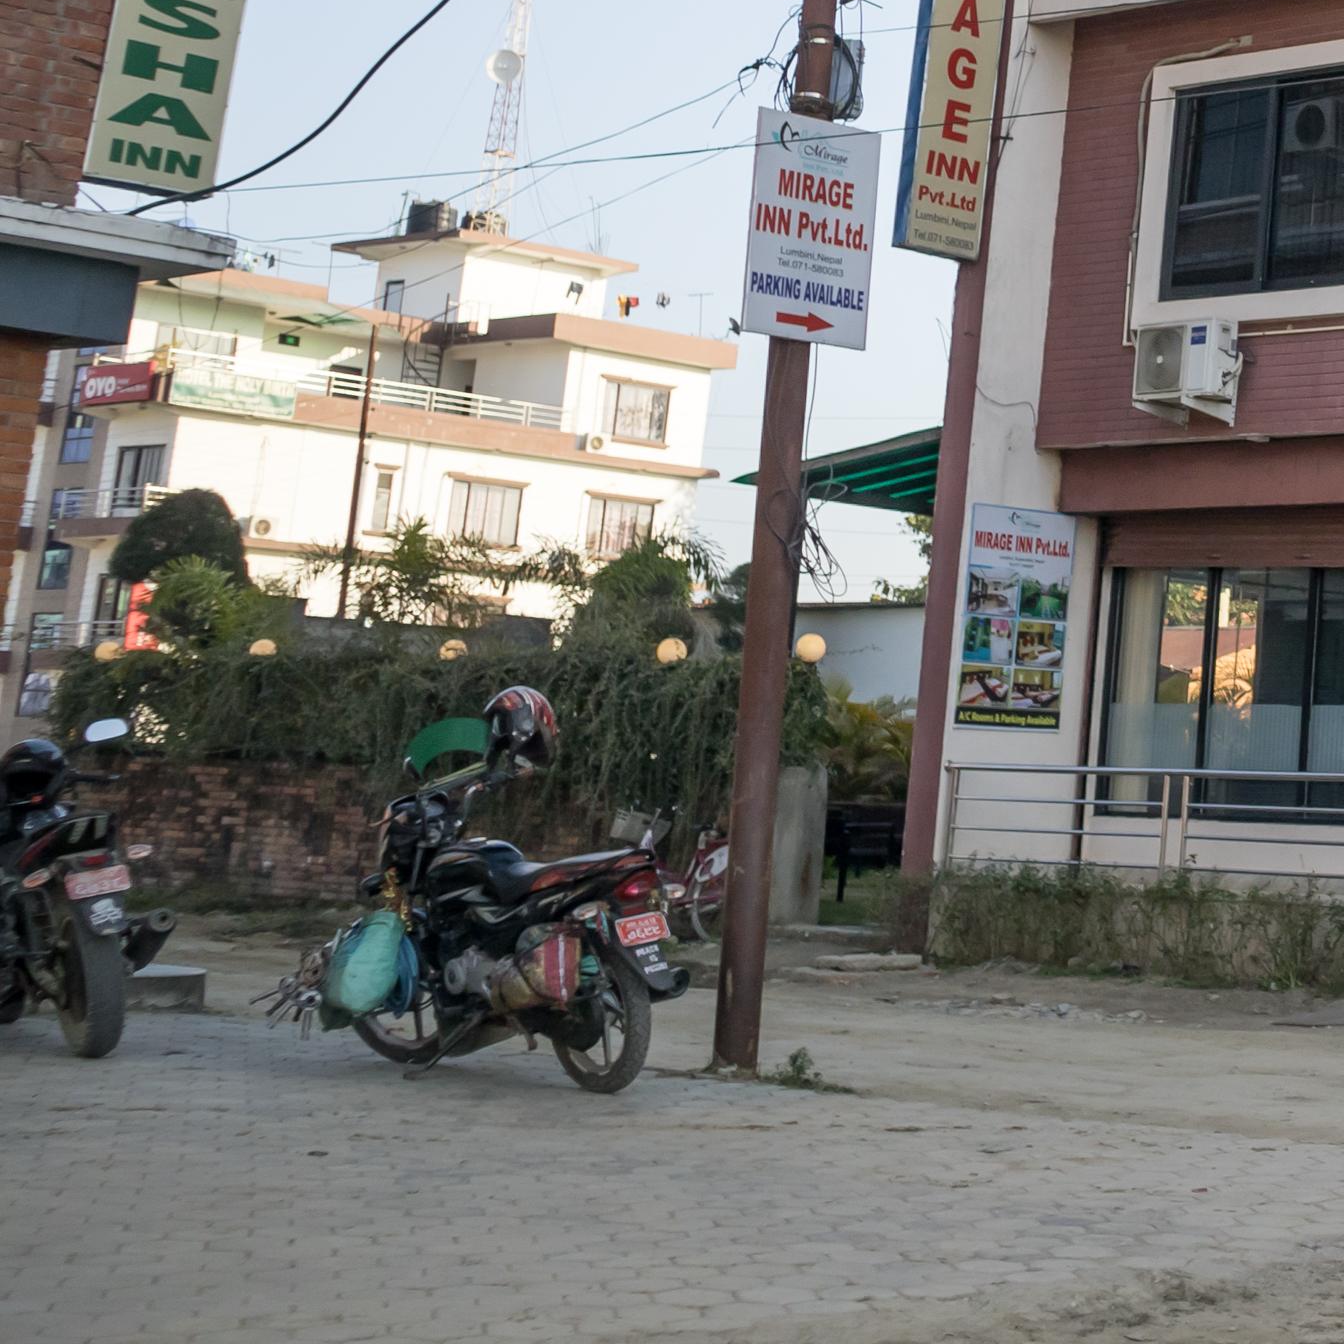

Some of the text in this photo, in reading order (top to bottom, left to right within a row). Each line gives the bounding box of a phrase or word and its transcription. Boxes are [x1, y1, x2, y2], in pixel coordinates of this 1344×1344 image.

[109, 138, 202, 178] INN
[804, 144, 848, 165] Mirage
[926, 150, 981, 184] INN
[778, 168, 854, 209] MIRAGE
[756, 203, 868, 251] INN Pvt.Ltd.
[751, 271, 864, 311] PARKING AVAILABLE
[85, 376, 116, 398] OYO
[975, 530, 1070, 558] MIRAGE INN Pvt.Ltd.
